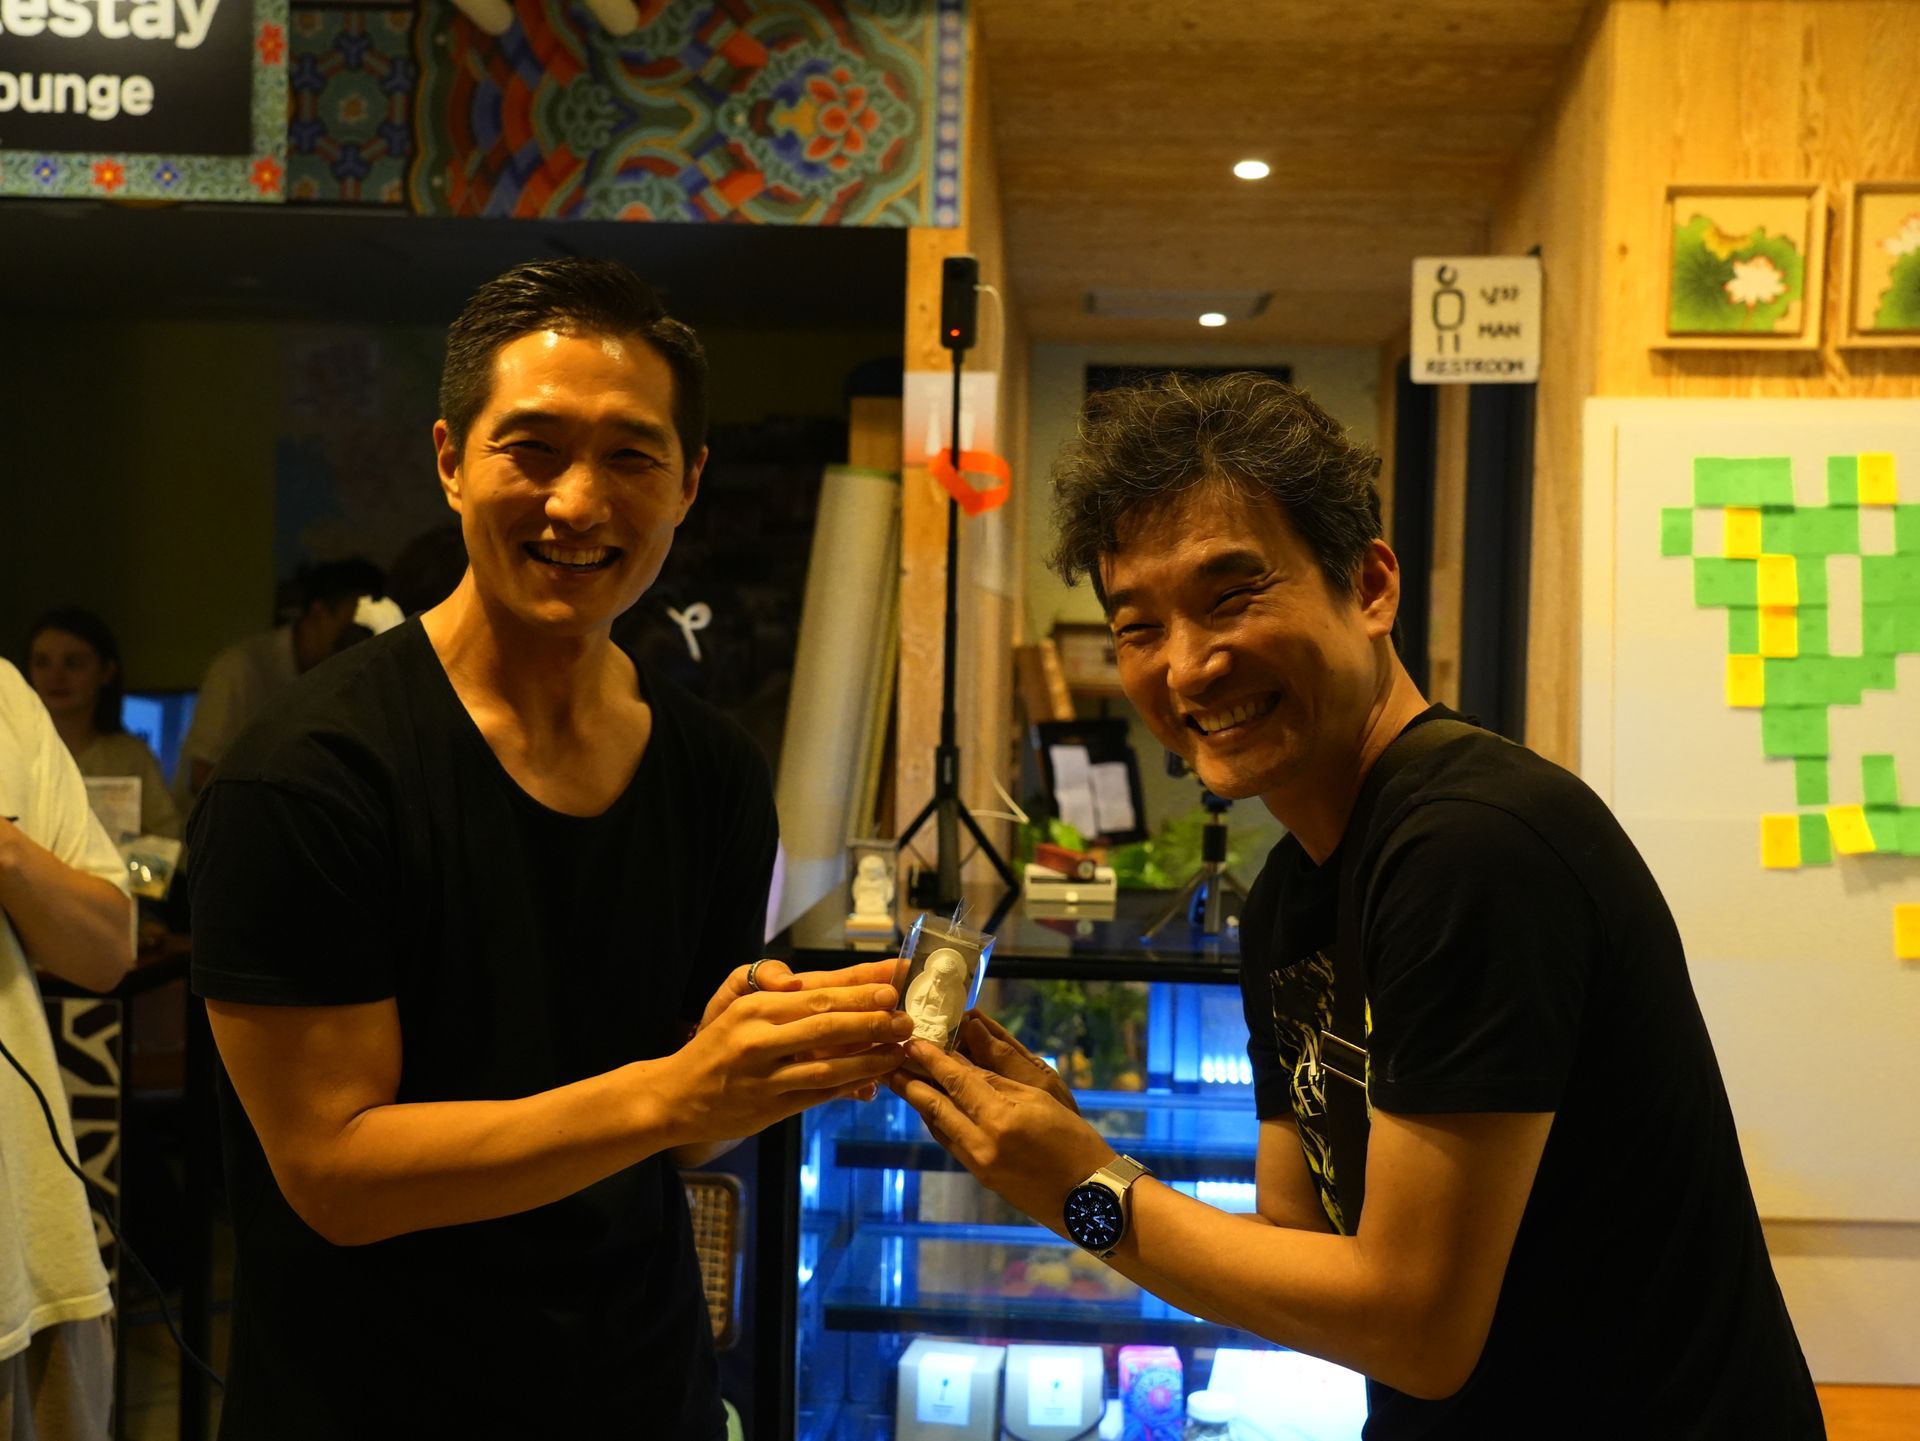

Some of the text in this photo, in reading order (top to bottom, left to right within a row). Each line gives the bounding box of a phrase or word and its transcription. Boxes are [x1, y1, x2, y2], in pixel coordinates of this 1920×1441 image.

[0, 0, 219, 49] estay
[1478, 323, 1521, 338] MAN
[1425, 359, 1524, 374] RESTROOM
